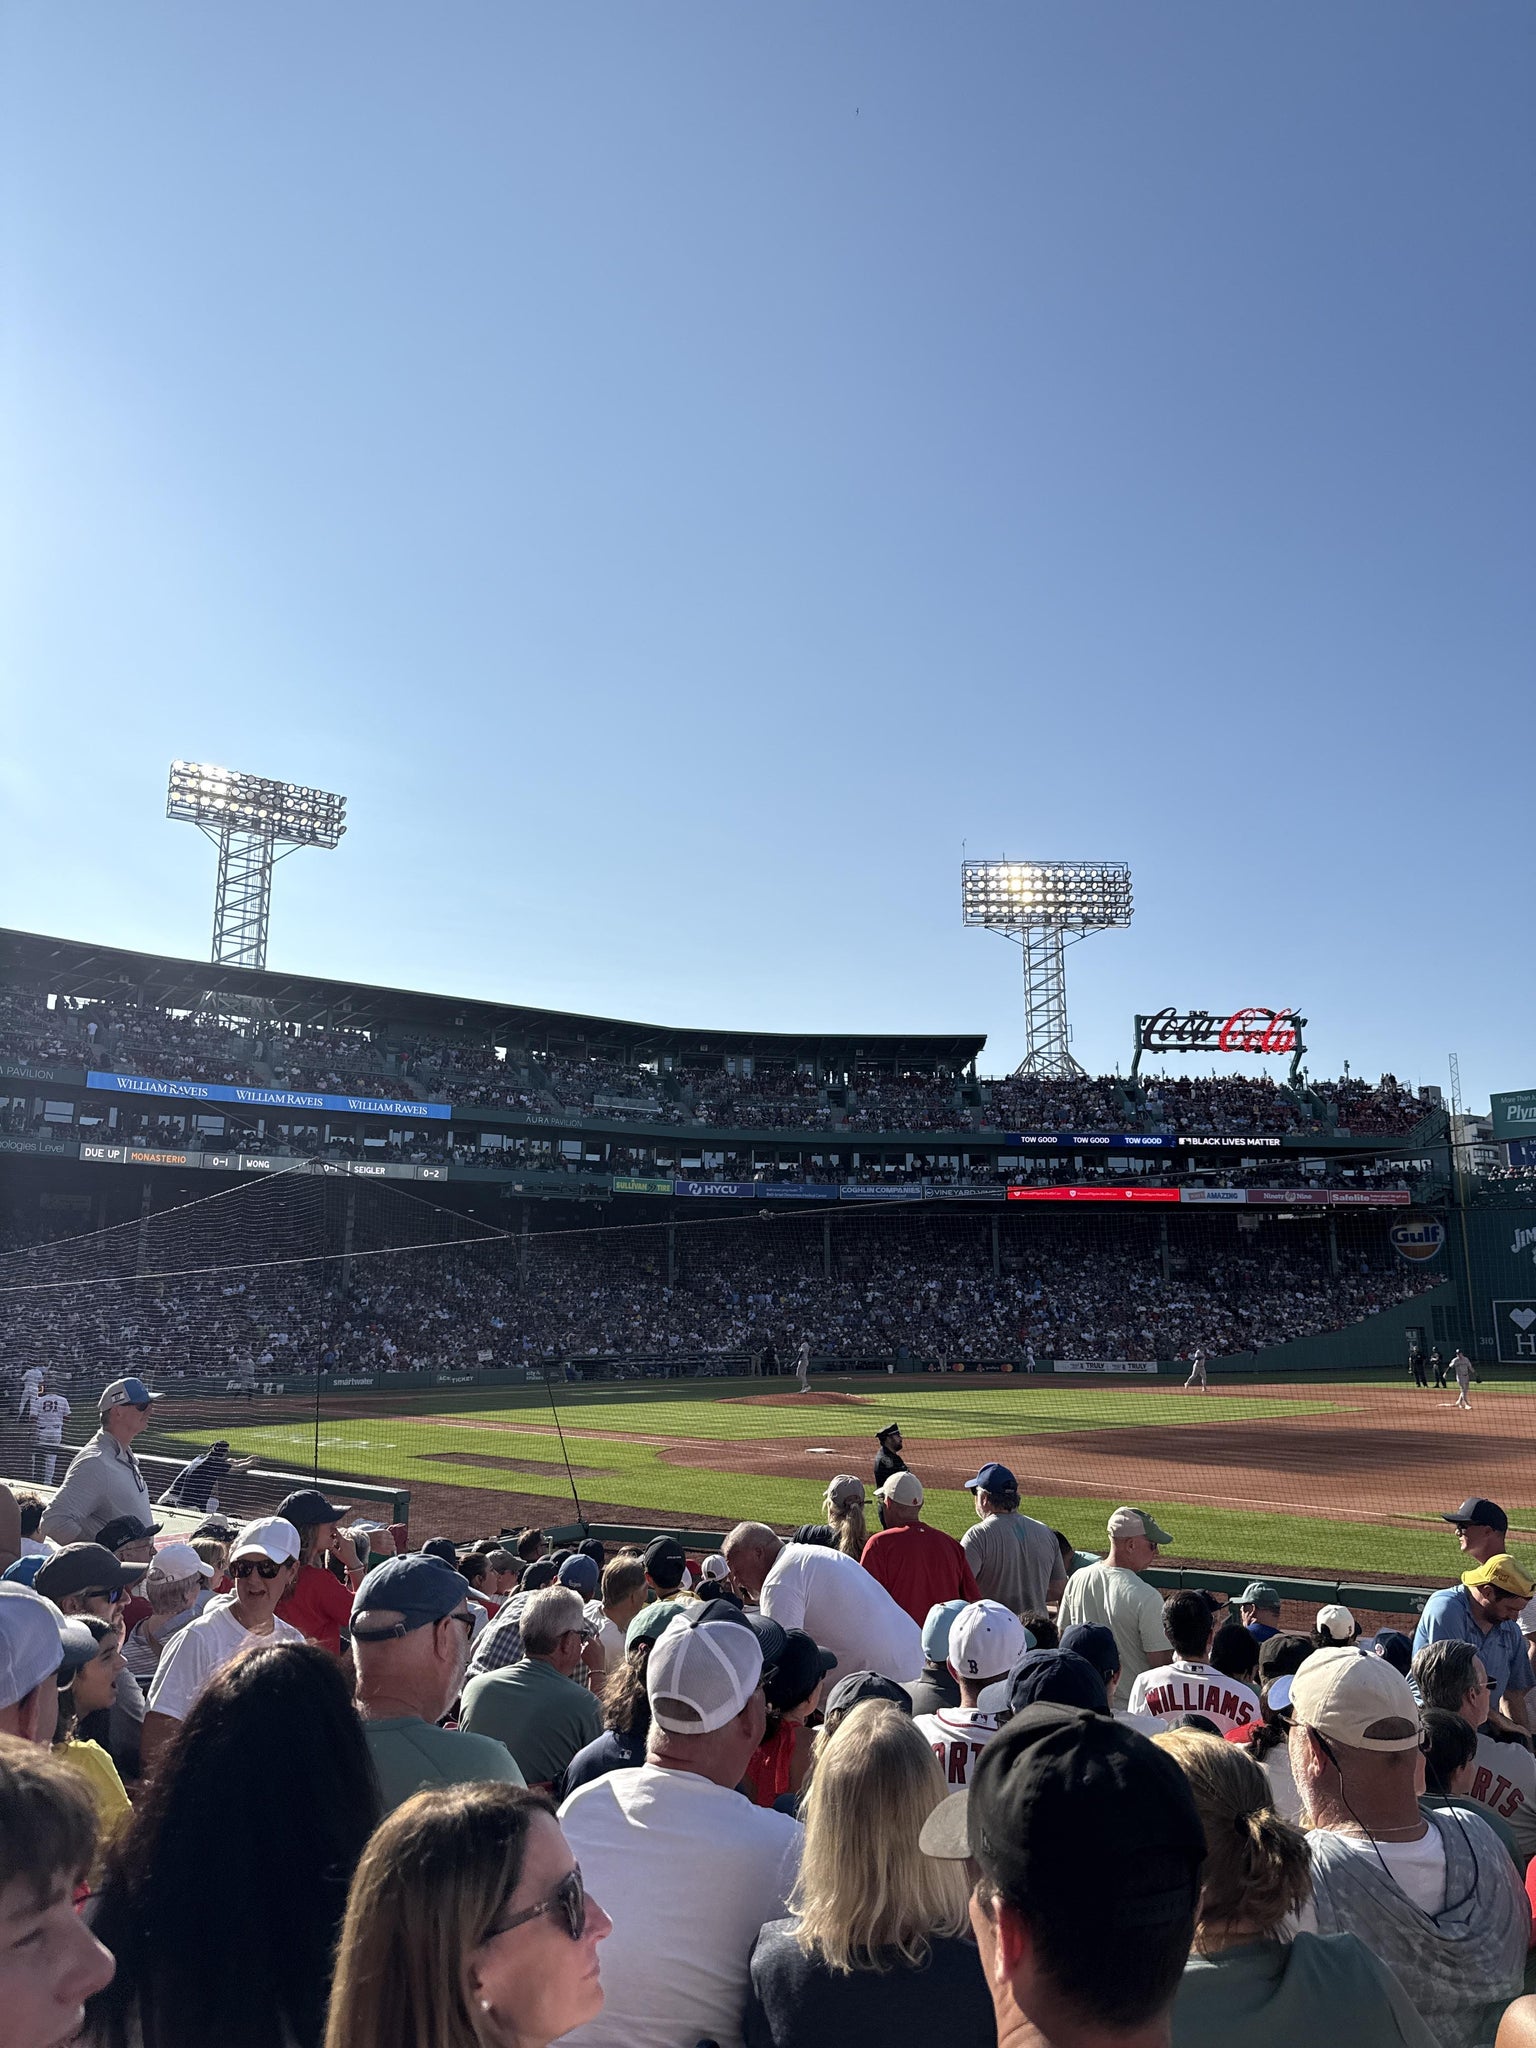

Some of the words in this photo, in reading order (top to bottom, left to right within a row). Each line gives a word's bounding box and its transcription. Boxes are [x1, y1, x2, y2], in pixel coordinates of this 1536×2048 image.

[1143, 1007, 1216, 1050] Coca
[1218, 1008, 1301, 1053] Cola
[7, 1066, 54, 1080] PAVILION
[116, 1077, 167, 1093] WILLIAM
[169, 1083, 208, 1097] RAVEIS
[236, 1089, 285, 1104] WILLIAM
[287, 1094, 323, 1107] RAVEIS
[348, 1099, 393, 1112] WILLIAM
[395, 1104, 428, 1115] RAVEIS
[551, 1118, 583, 1127] PAVILION
[39, 1141, 65, 1152] Level
[1192, 1137, 1220, 1145] BLACK
[1221, 1137, 1246, 1146] LIVES
[1247, 1138, 1280, 1146] MATTER
[84, 1147, 104, 1158] DUE
[107, 1150, 120, 1159] UP
[130, 1152, 187, 1164] MONASTERIO
[212, 1157, 228, 1166] 0-1
[246, 1159, 270, 1169] WONG
[354, 1165, 386, 1175] SEIGLER
[423, 1169, 439, 1178] 0-2
[616, 1180, 647, 1190] SULLIVAN
[657, 1184, 671, 1192] TIRE
[704, 1185, 737, 1194] HYCU
[1392, 1226, 1440, 1243] Gulf
[1480, 1337, 1494, 1345] 310
[333, 1377, 374, 1386] smartwater
[42, 1400, 58, 1413] 81
[967, 1659, 979, 1674] B
[1144, 1683, 1254, 1726] WILLIAMS
[1470, 1765, 1525, 1818] RTS
